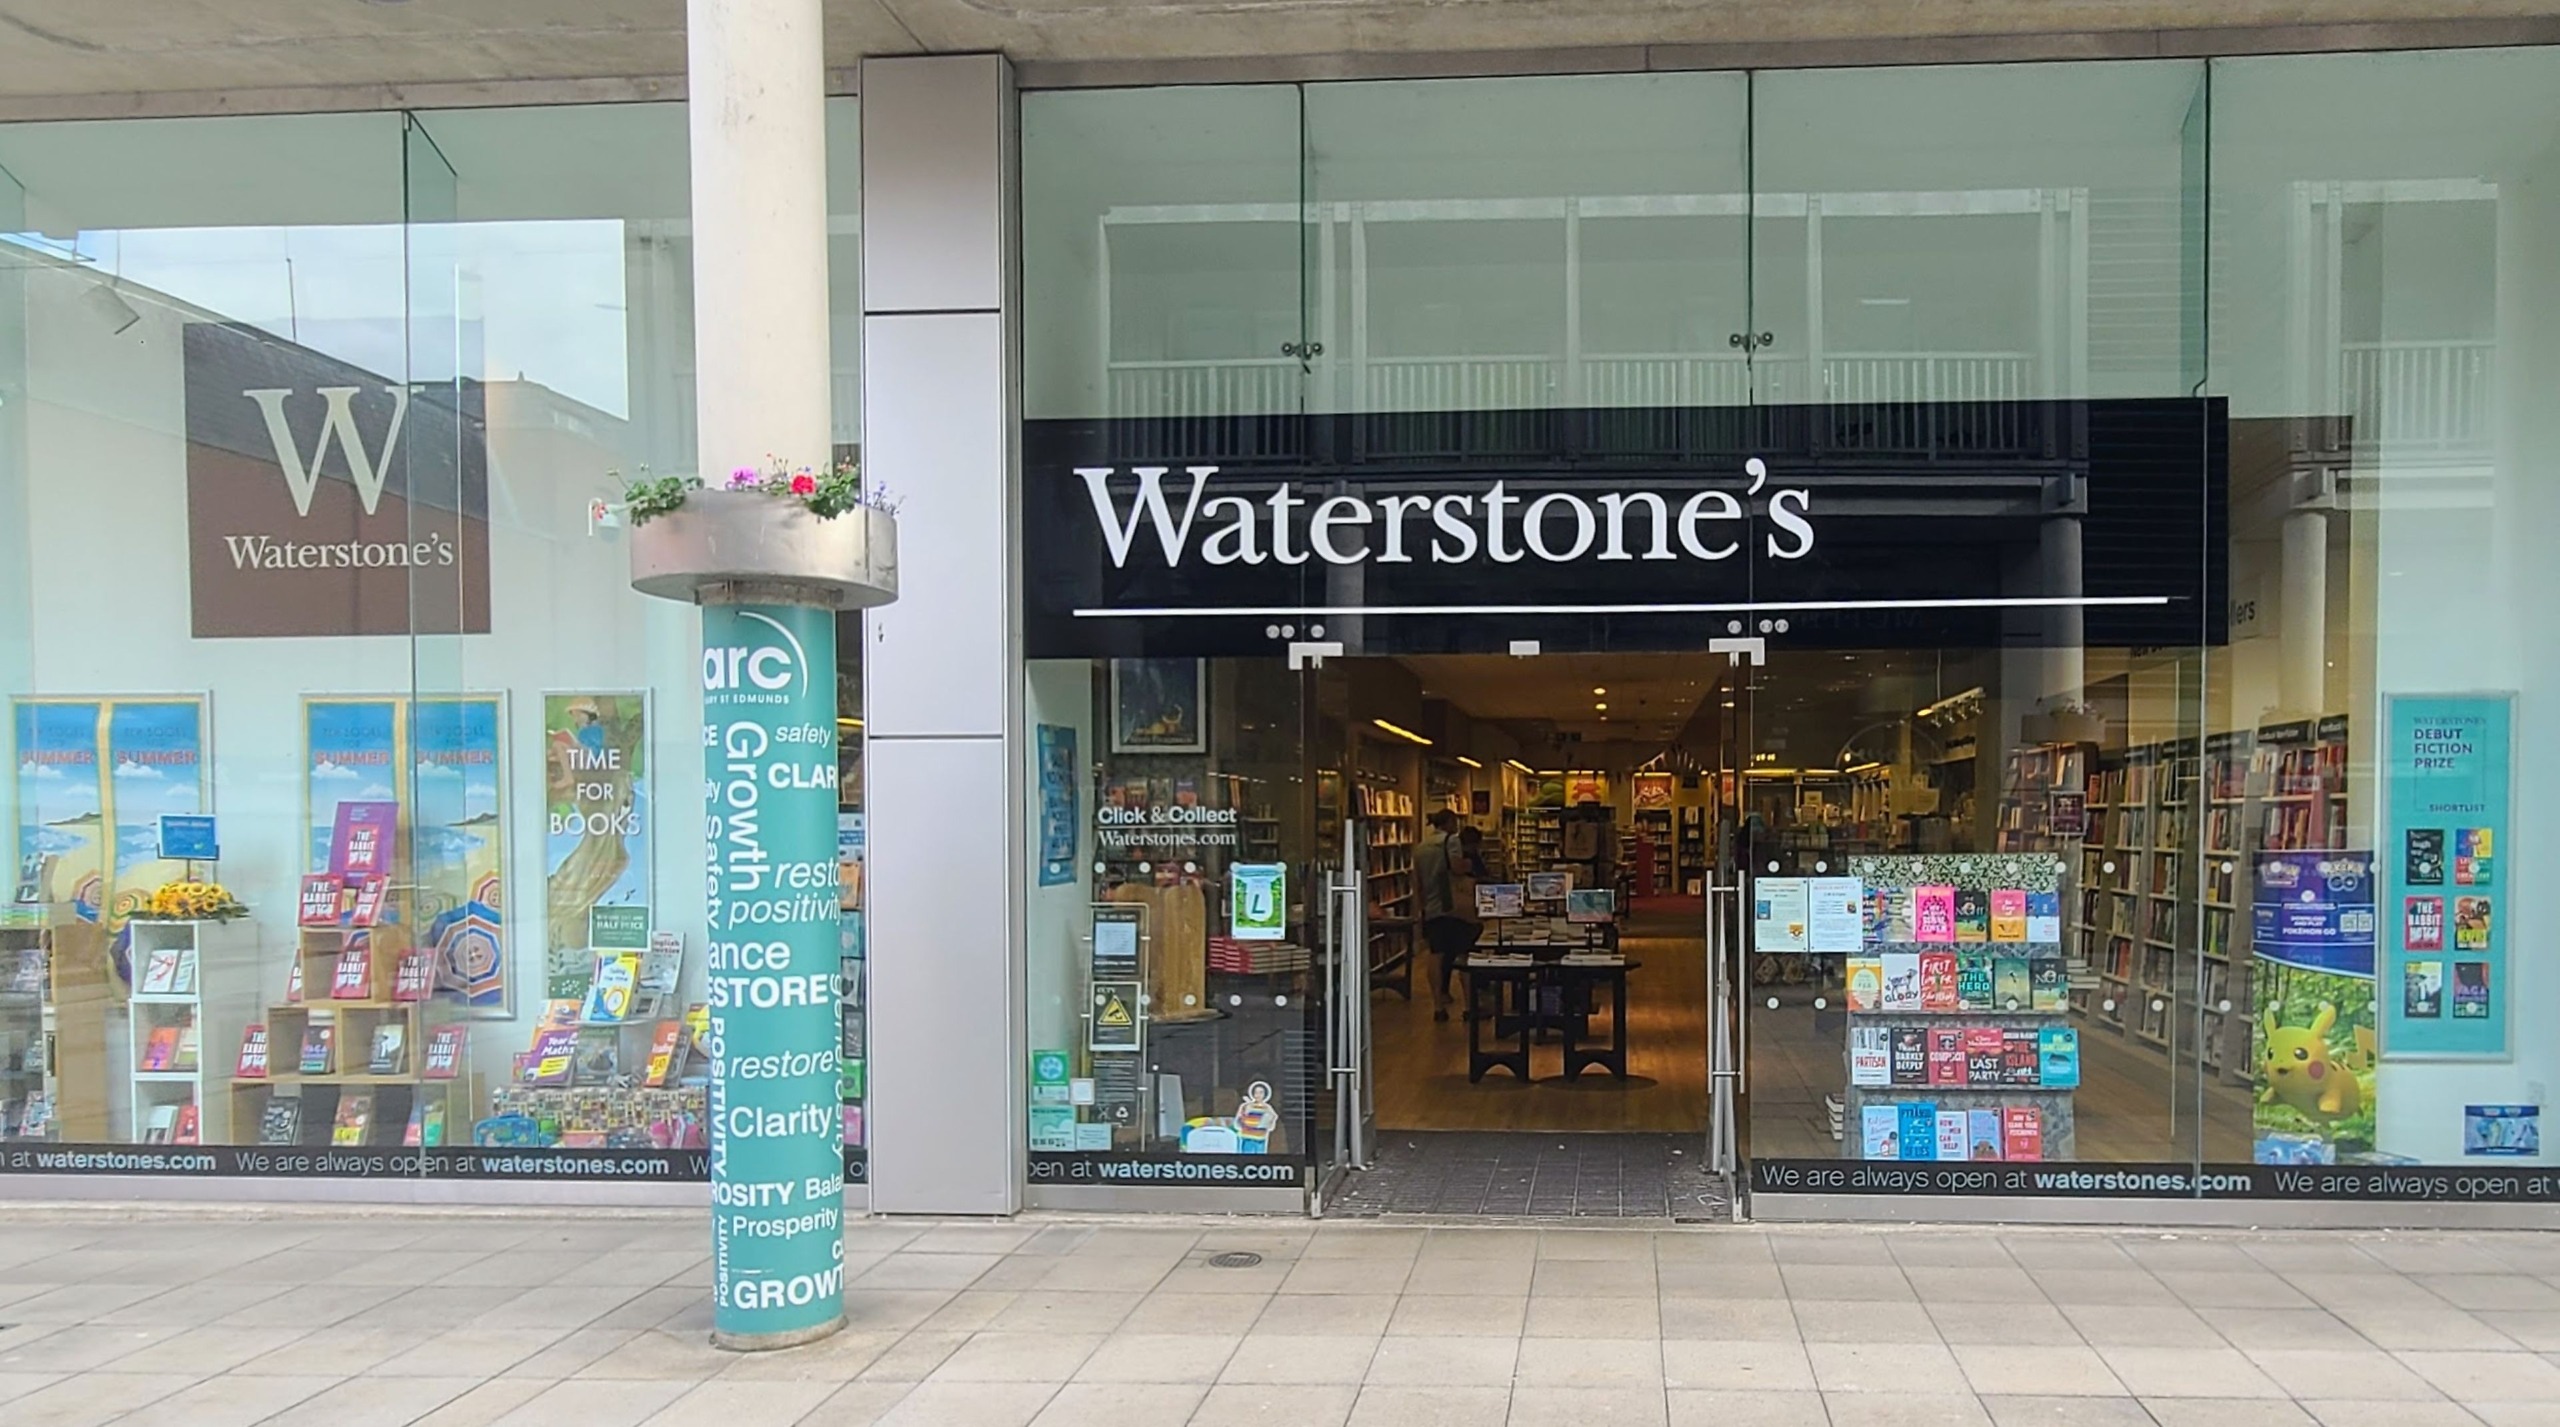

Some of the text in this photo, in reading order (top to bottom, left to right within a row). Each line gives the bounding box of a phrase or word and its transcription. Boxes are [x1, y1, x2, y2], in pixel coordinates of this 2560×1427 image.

[243, 385, 425, 517] W
[1072, 457, 1815, 568] Waterstone's
[223, 533, 454, 569] Waterstone's
[703, 646, 792, 690] arc
[733, 694, 790, 705] EDMUNDS
[775, 722, 831, 748] safety
[2414, 728, 2463, 740] DEBUT
[2414, 743, 2473, 755] FICTION
[22, 751, 94, 765] SUMMER
[117, 751, 197, 765] SUMMER
[314, 751, 390, 765] SUMMER
[416, 751, 493, 765] SUMMER
[567, 749, 621, 771] TIME
[2414, 757, 2455, 769] PRIZE
[576, 783, 614, 801] FOR
[726, 721, 771, 892] Growth
[2429, 804, 2486, 813] SHORTLIST
[1097, 806, 1237, 824] Click & Collect
[550, 812, 641, 836] BOOKS
[1098, 830, 1237, 847] Waterstones.com
[2416, 902, 2435, 913] THE
[597, 921, 619, 930] HALF
[2407, 914, 2441, 926] RABBIT
[2323, 928, 2337, 936] GO
[346, 951, 362, 962] THE
[709, 941, 791, 971] ance
[337, 962, 366, 974] RABBIT
[1922, 959, 1951, 974] FIRST
[1963, 972, 1985, 982] THE
[1958, 982, 1990, 991] HERD
[1884, 991, 1919, 1003] GLORY
[540, 1046, 575, 1057] Maths
[730, 1049, 833, 1080] restore
[1970, 1058, 1999, 1070] LAST
[1968, 1070, 2001, 1081] PARTY
[711, 1016, 728, 1178] POSITIVITY
[730, 1103, 833, 1139] Clarity
[11, 1152, 217, 1171] at waterstones.com
[235, 1153, 669, 1177] We are always open at waterstones.com
[1072, 1160, 1092, 1177] at
[1099, 1161, 1294, 1181] waterstones.com
[1762, 1165, 2252, 1194] We are always open at waterstones.com
[2275, 1171, 2551, 1199] We are always open at
[733, 1208, 839, 1240] Prosperity
[718, 1214, 729, 1307] POSITIVITY
